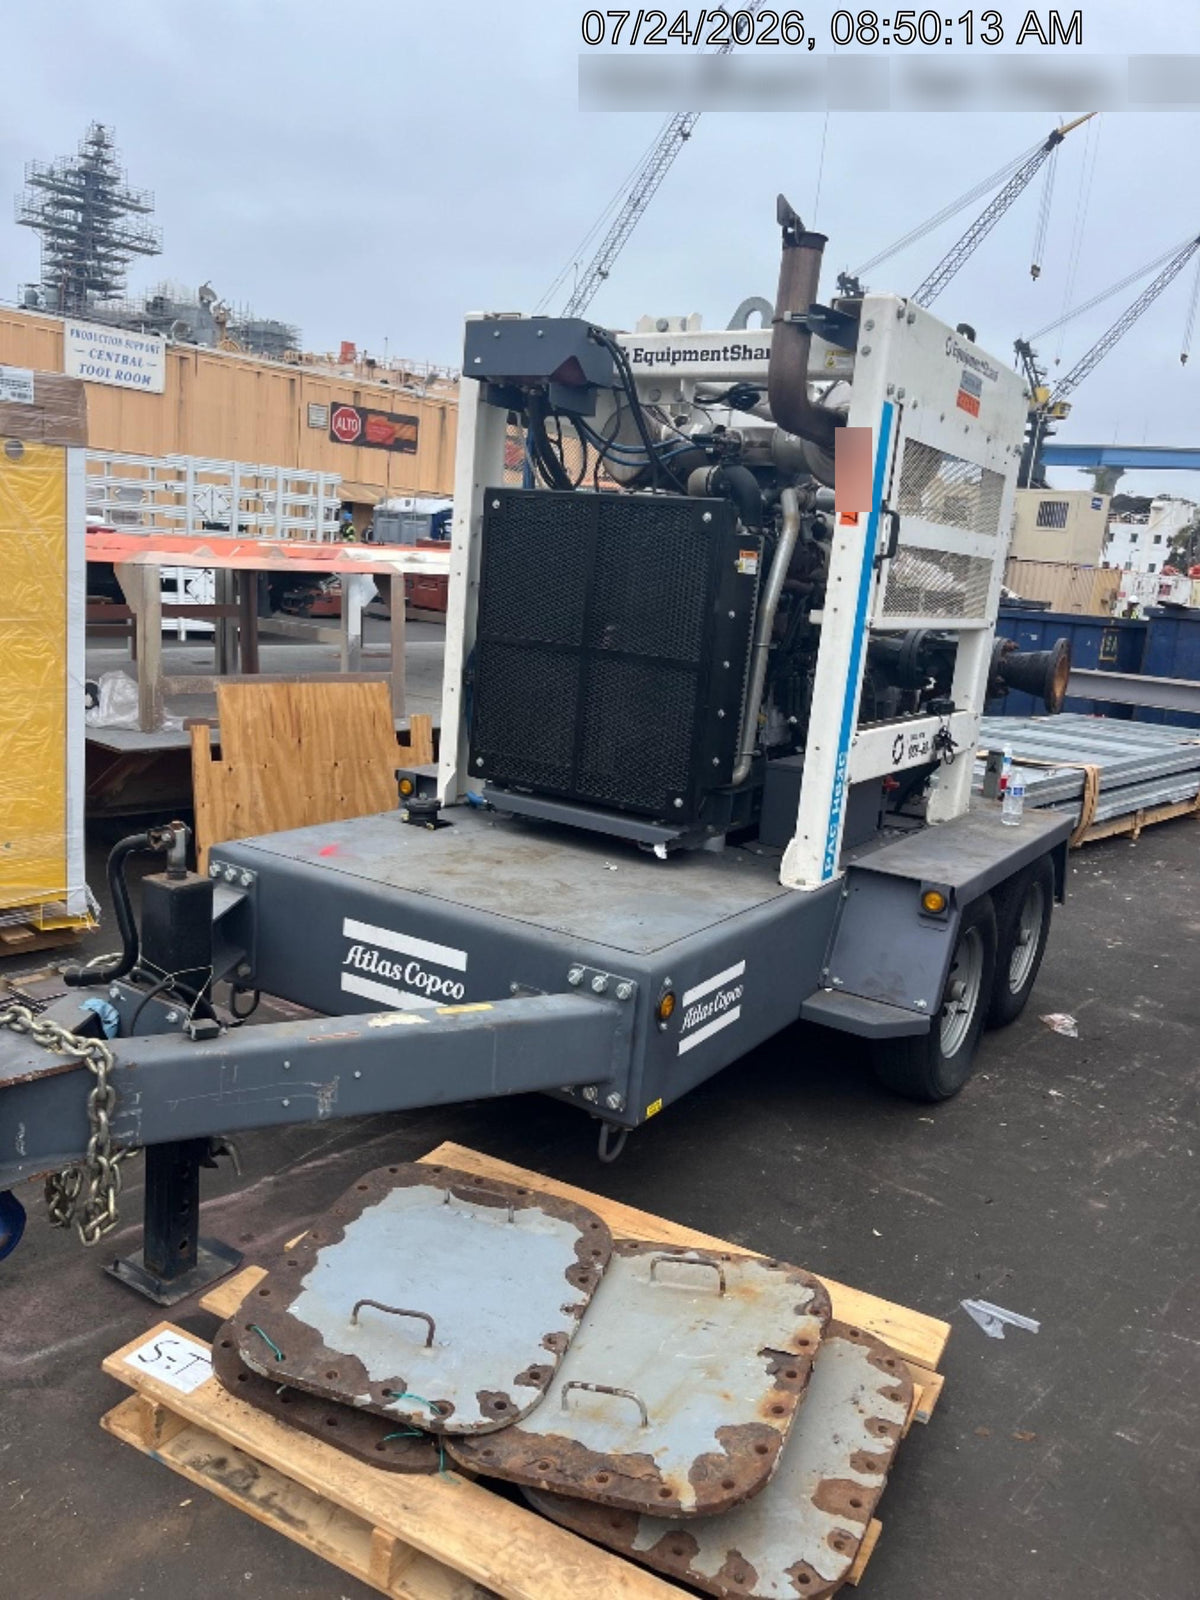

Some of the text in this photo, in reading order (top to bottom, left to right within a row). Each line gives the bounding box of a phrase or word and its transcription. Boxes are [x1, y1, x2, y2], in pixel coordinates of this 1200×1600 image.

[70, 328, 160, 355] PRODUCTION SUPPORT
[89, 348, 144, 368] CENTRAL
[79, 363, 152, 386] TOOL ROOM
[335, 417, 358, 432] ALTO
[342, 945, 465, 1000] Atlas Copco
[679, 984, 744, 1034] Atlas Copco
